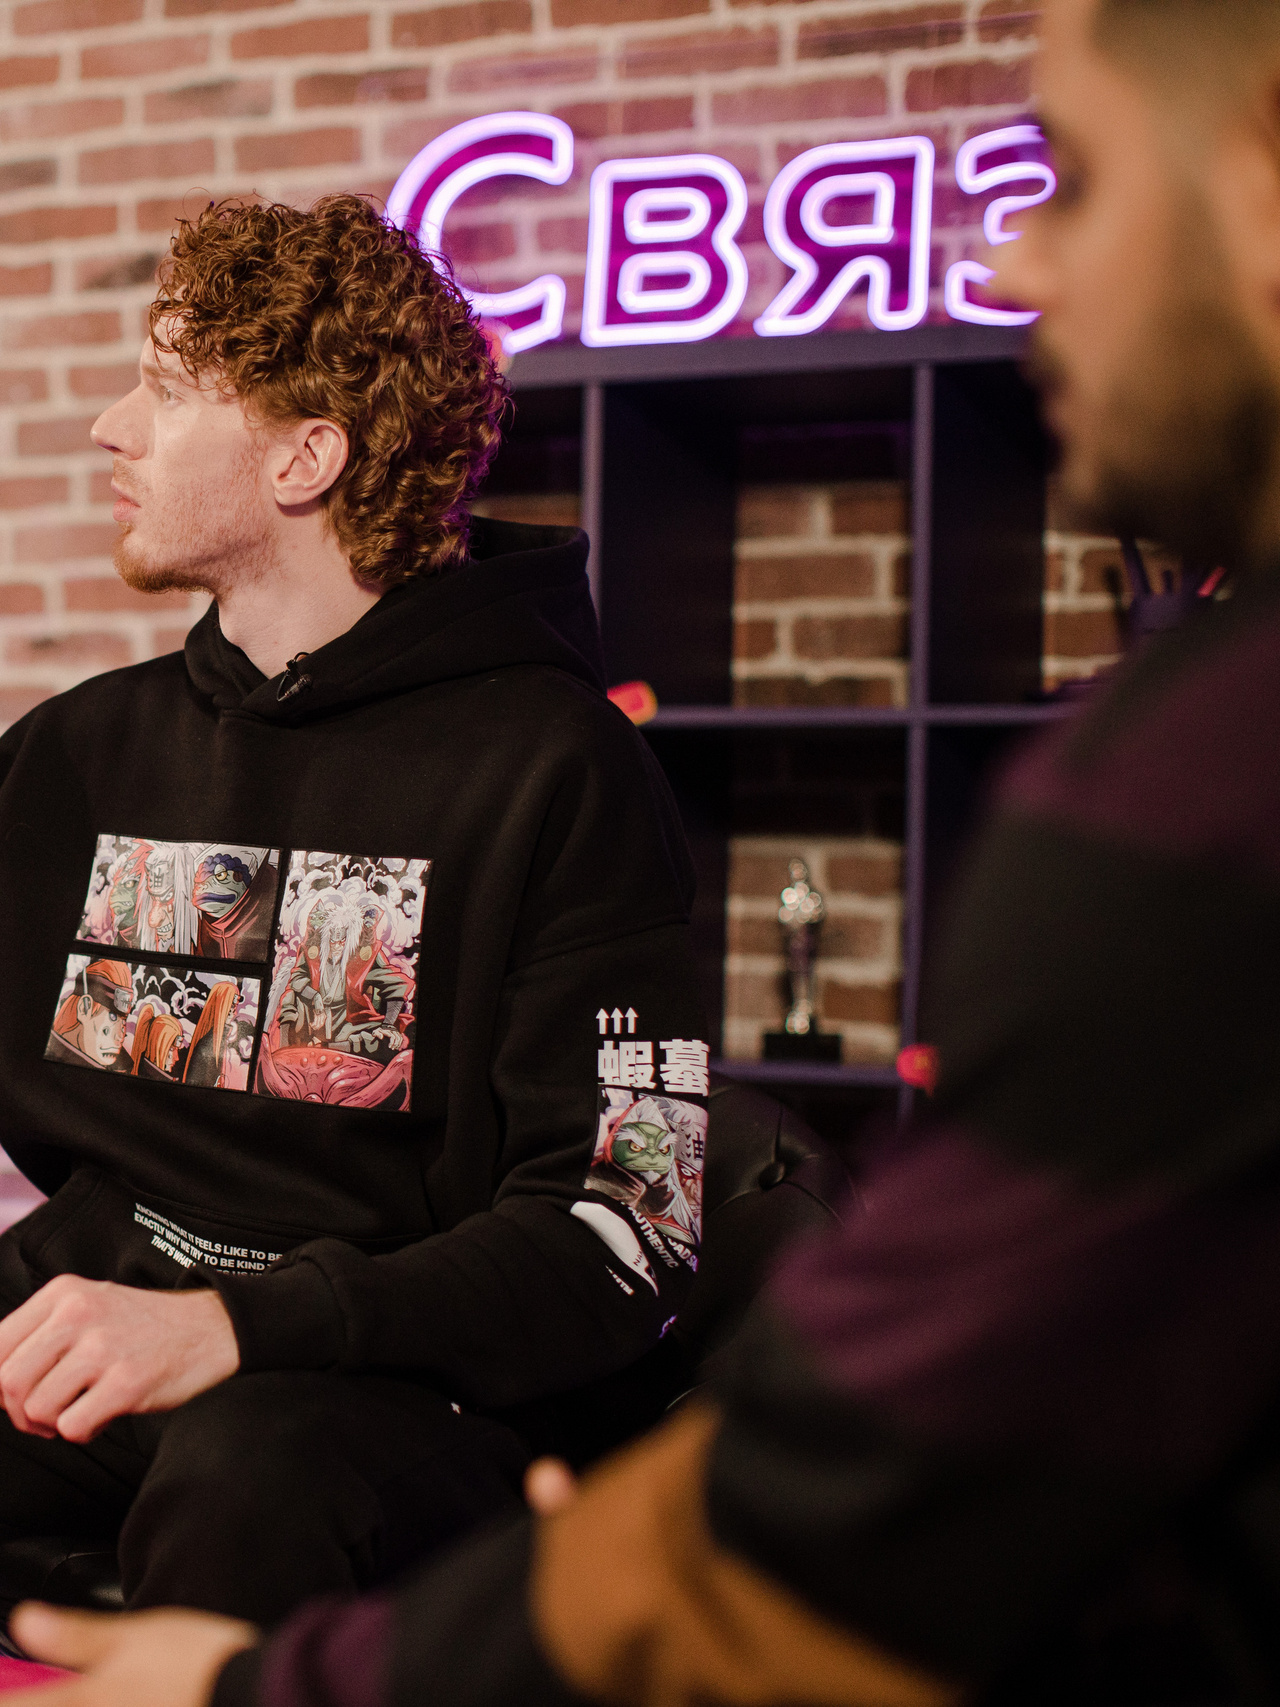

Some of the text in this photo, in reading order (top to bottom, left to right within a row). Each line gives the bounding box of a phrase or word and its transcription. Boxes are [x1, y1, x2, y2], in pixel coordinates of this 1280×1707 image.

[134, 1211, 265, 1271] EXACTLY WHY WE TRY TO BE KIND
[151, 1235, 193, 1269] THAT'S WHAT
[169, 1221, 188, 1239] WHAT
[187, 1233, 195, 1243] IT
[194, 1236, 222, 1254] FEELS
[223, 1245, 248, 1258] LIKE
[250, 1250, 266, 1261] TO
